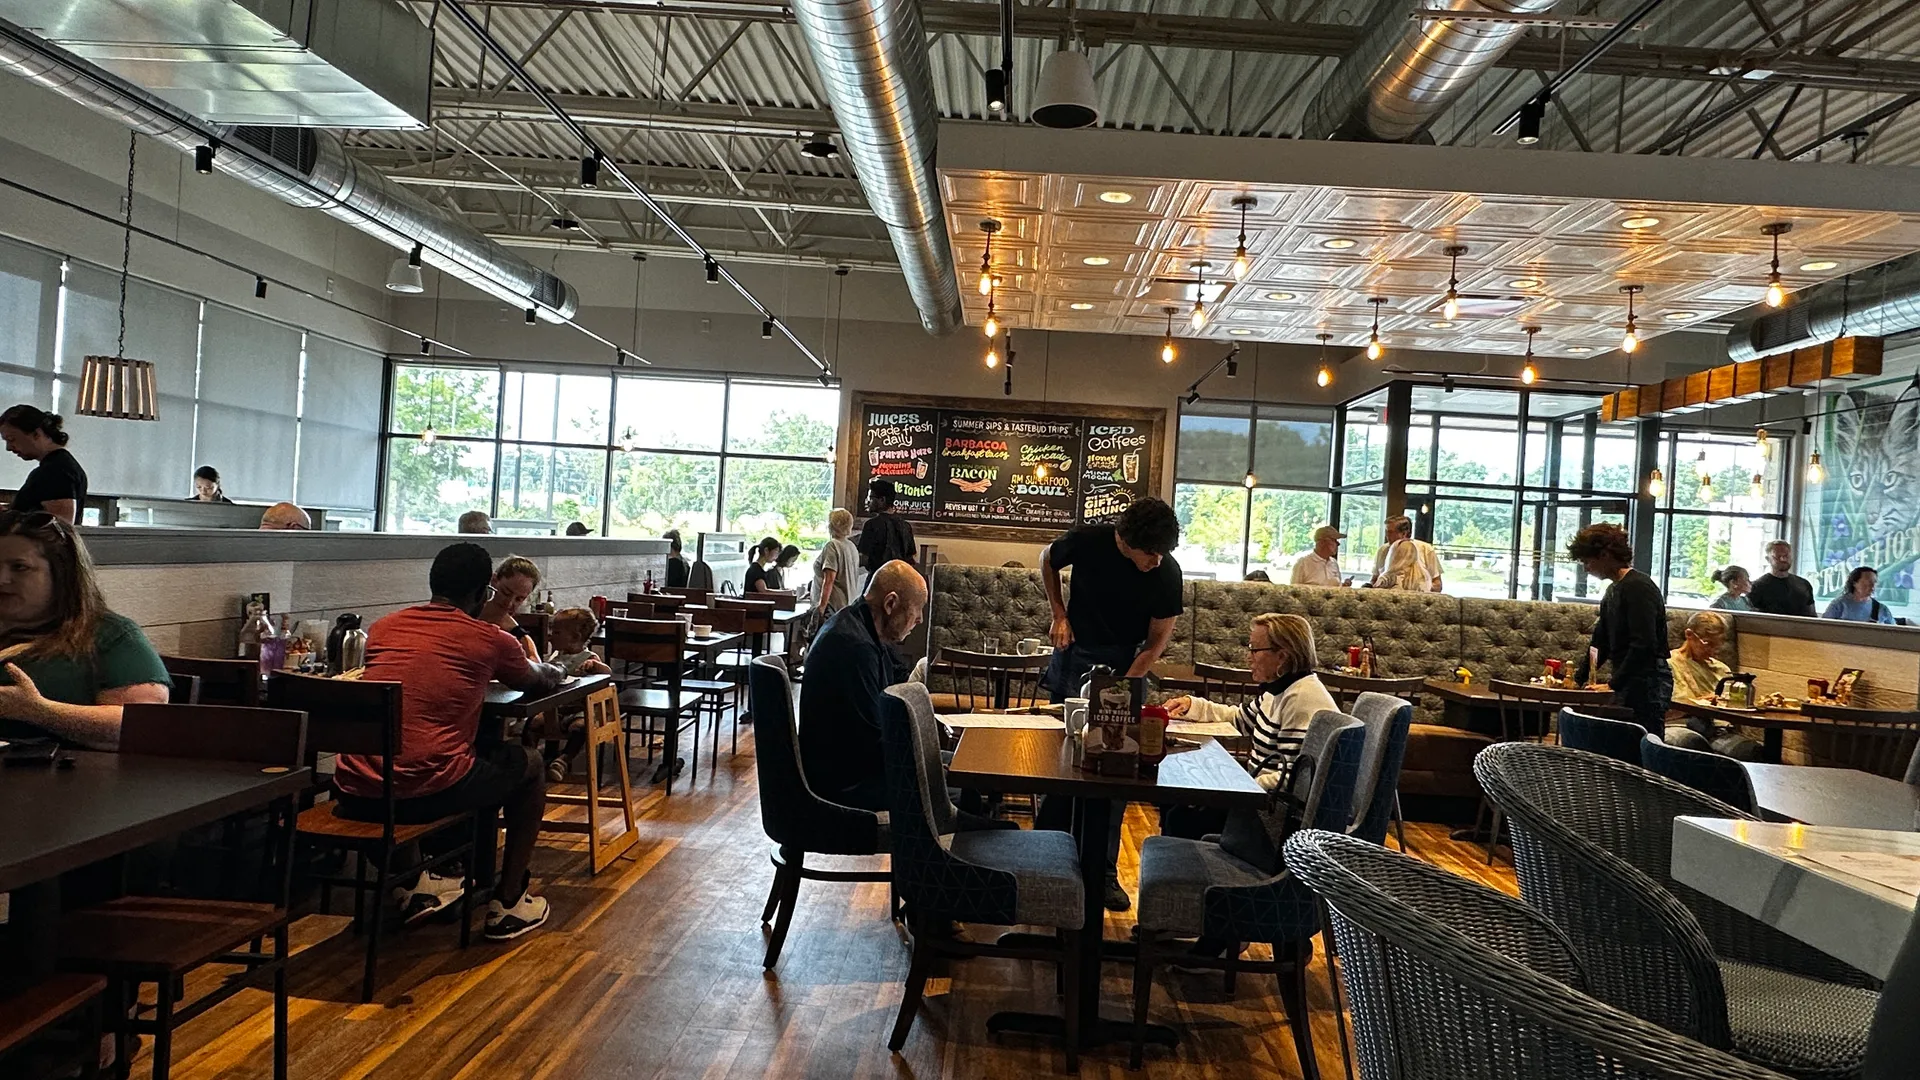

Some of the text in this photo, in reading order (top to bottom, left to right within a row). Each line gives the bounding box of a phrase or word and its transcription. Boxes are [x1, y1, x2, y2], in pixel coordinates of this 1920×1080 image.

[868, 412, 920, 427] JUICES
[867, 420, 934, 446] Made fresh
[952, 419, 1069, 435] SUMMER SIPS & TASTEBUD TRIPS
[1089, 425, 1135, 435] ICED
[882, 433, 913, 448] daily
[945, 437, 1008, 451] BARBACOA
[1087, 433, 1147, 452] Coffees
[879, 447, 933, 459] Purple Haze
[941, 446, 985, 461] breakfast
[1020, 443, 1065, 455] Chicken
[950, 467, 998, 481] BACON
[1011, 474, 1024, 484] AM
[1082, 473, 1113, 482] MOCHA
[1016, 484, 1066, 496] BOWL
[893, 499, 932, 509] OUR JUICE
[944, 502, 968, 511] REVIEW
[1084, 497, 1114, 509] GIFT
[1083, 502, 1132, 519] BRUNC
[1111, 715, 1136, 724] COFFEE
